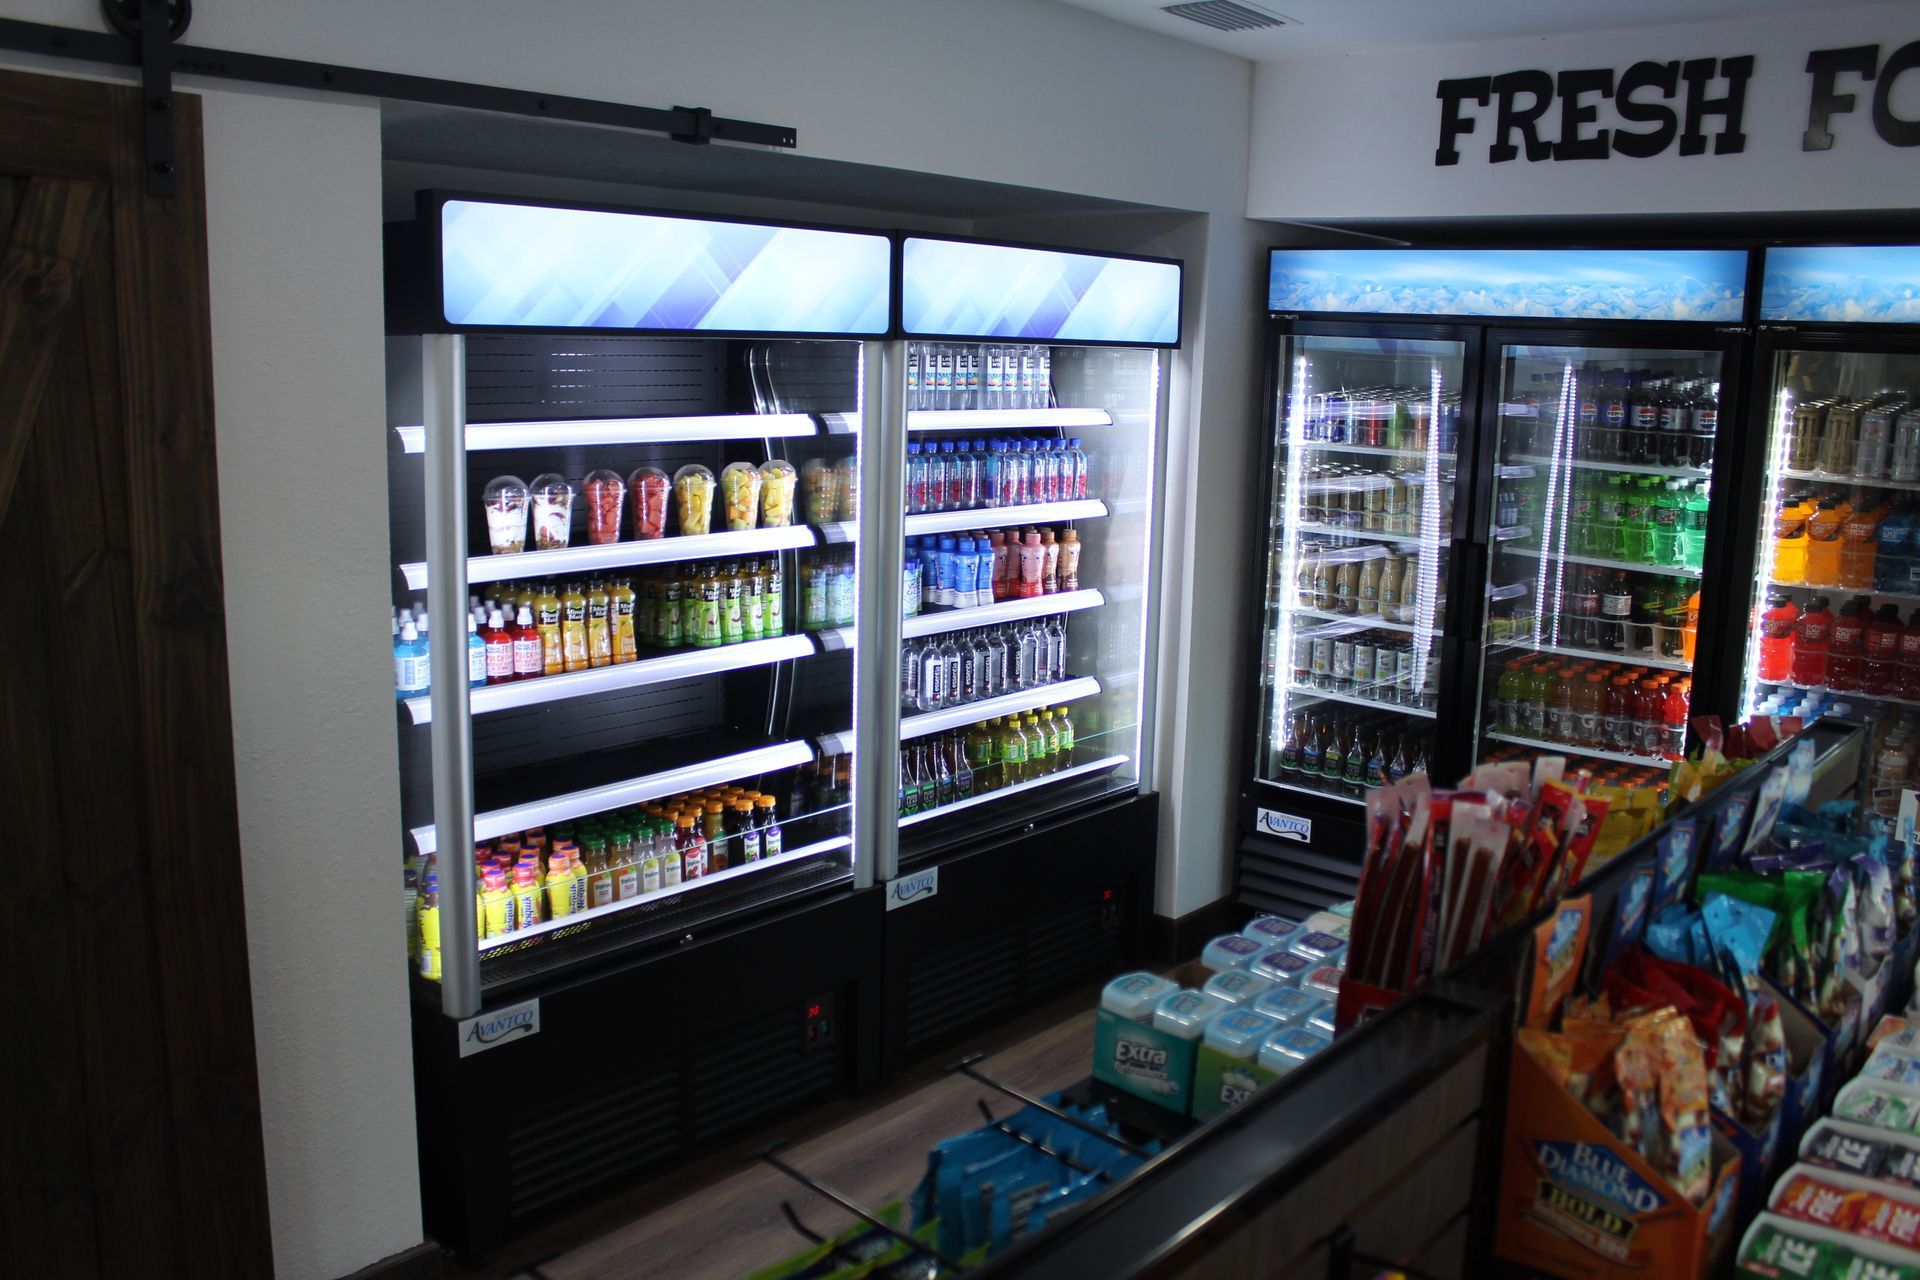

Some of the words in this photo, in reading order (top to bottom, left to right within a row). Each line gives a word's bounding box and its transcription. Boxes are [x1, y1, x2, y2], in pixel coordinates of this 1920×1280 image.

[1434, 54, 1755, 167] FRESH
[1580, 714, 1594, 728] G
[1604, 717, 1614, 730] G
[1632, 721, 1642, 736] G
[1259, 811, 1309, 836] AVANTCO
[506, 901, 514, 933] Nesquik
[524, 896, 534, 928] Nesquik
[466, 1010, 533, 1043] AVANTCO
[1116, 1040, 1168, 1065] Extra
[1220, 1084, 1250, 1104] Ext
[1538, 1144, 1659, 1213] DIAMOND
[1572, 1141, 1631, 1185] BLUE
[1550, 1186, 1624, 1234] BOLD
